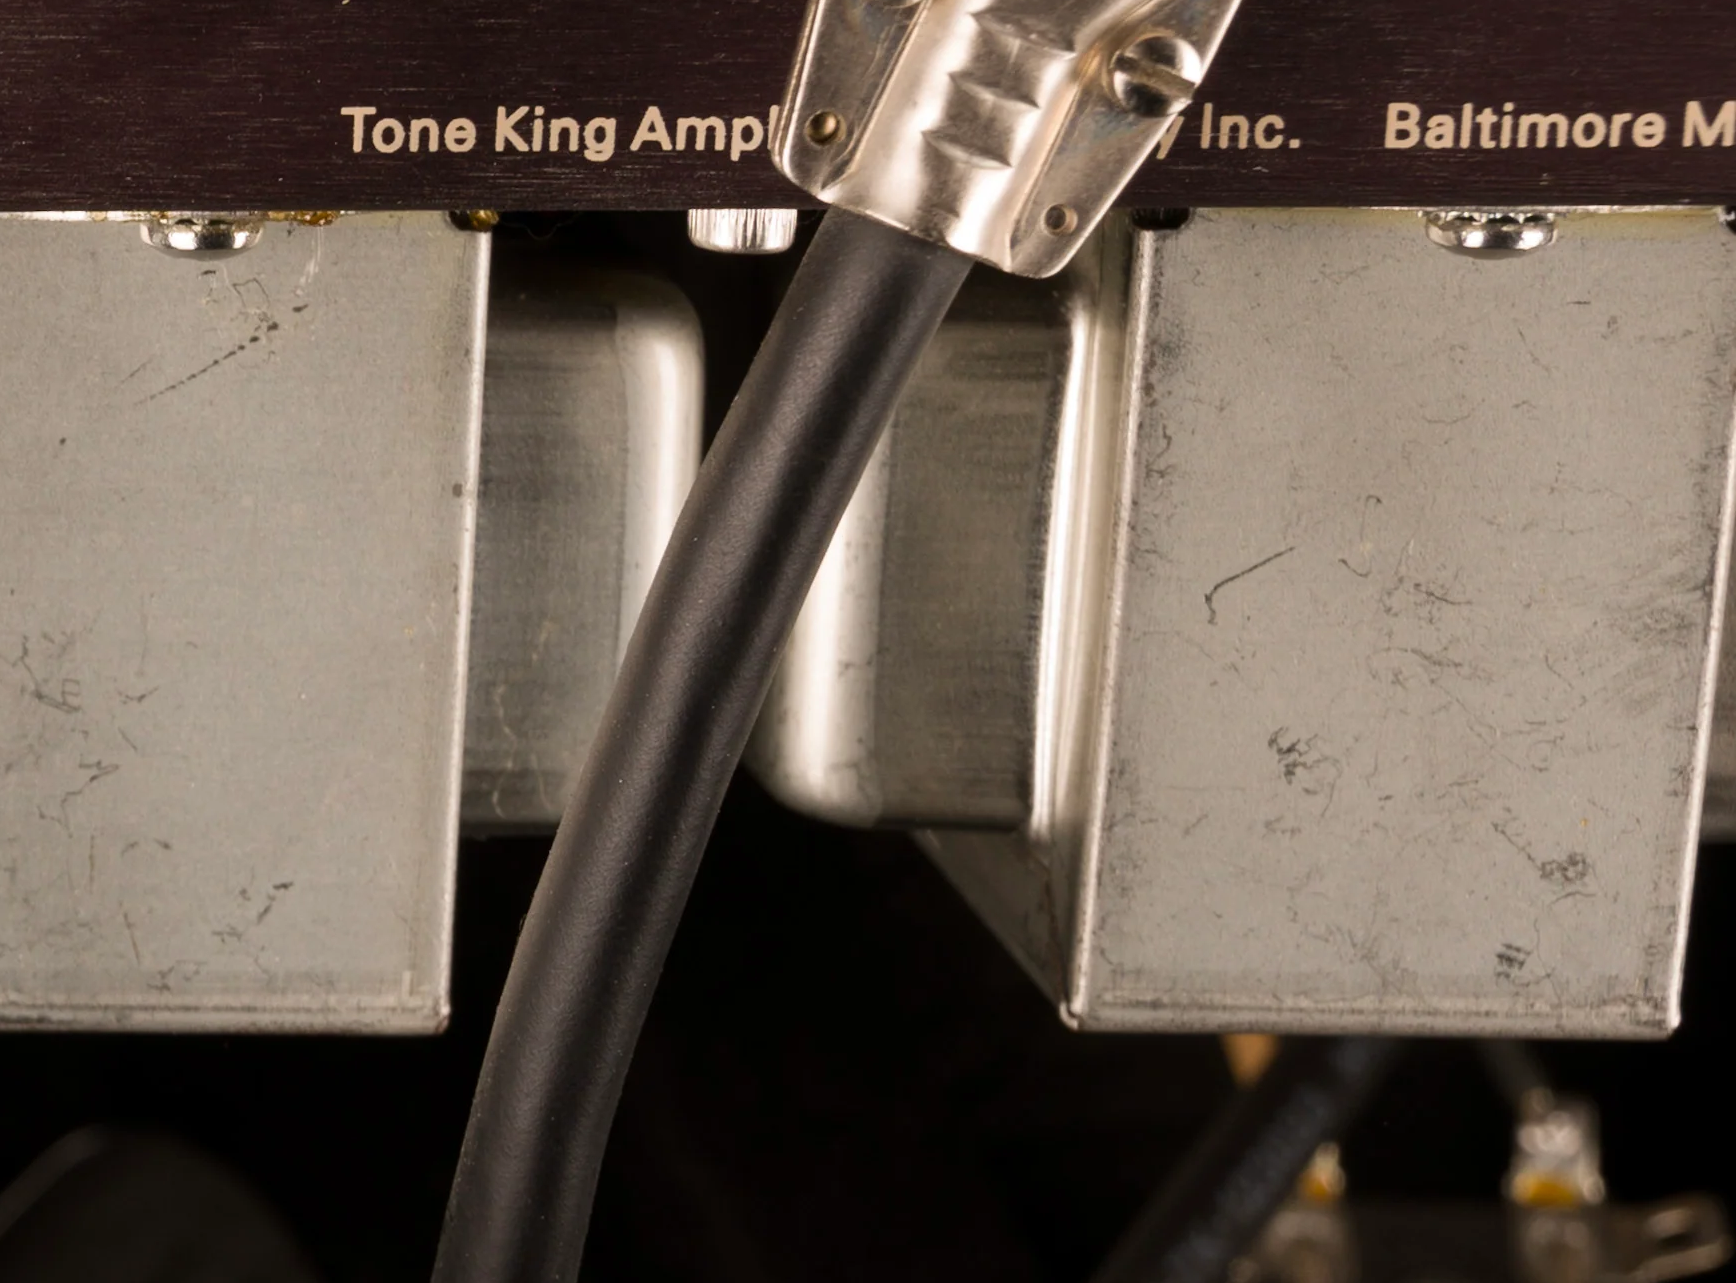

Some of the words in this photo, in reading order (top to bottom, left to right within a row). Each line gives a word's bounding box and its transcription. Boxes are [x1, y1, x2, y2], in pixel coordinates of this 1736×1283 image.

[341, 106, 477, 153] Tone
[495, 106, 616, 162] King
[1201, 103, 1301, 149] Inc.
[1385, 102, 1666, 149] Baltimore
